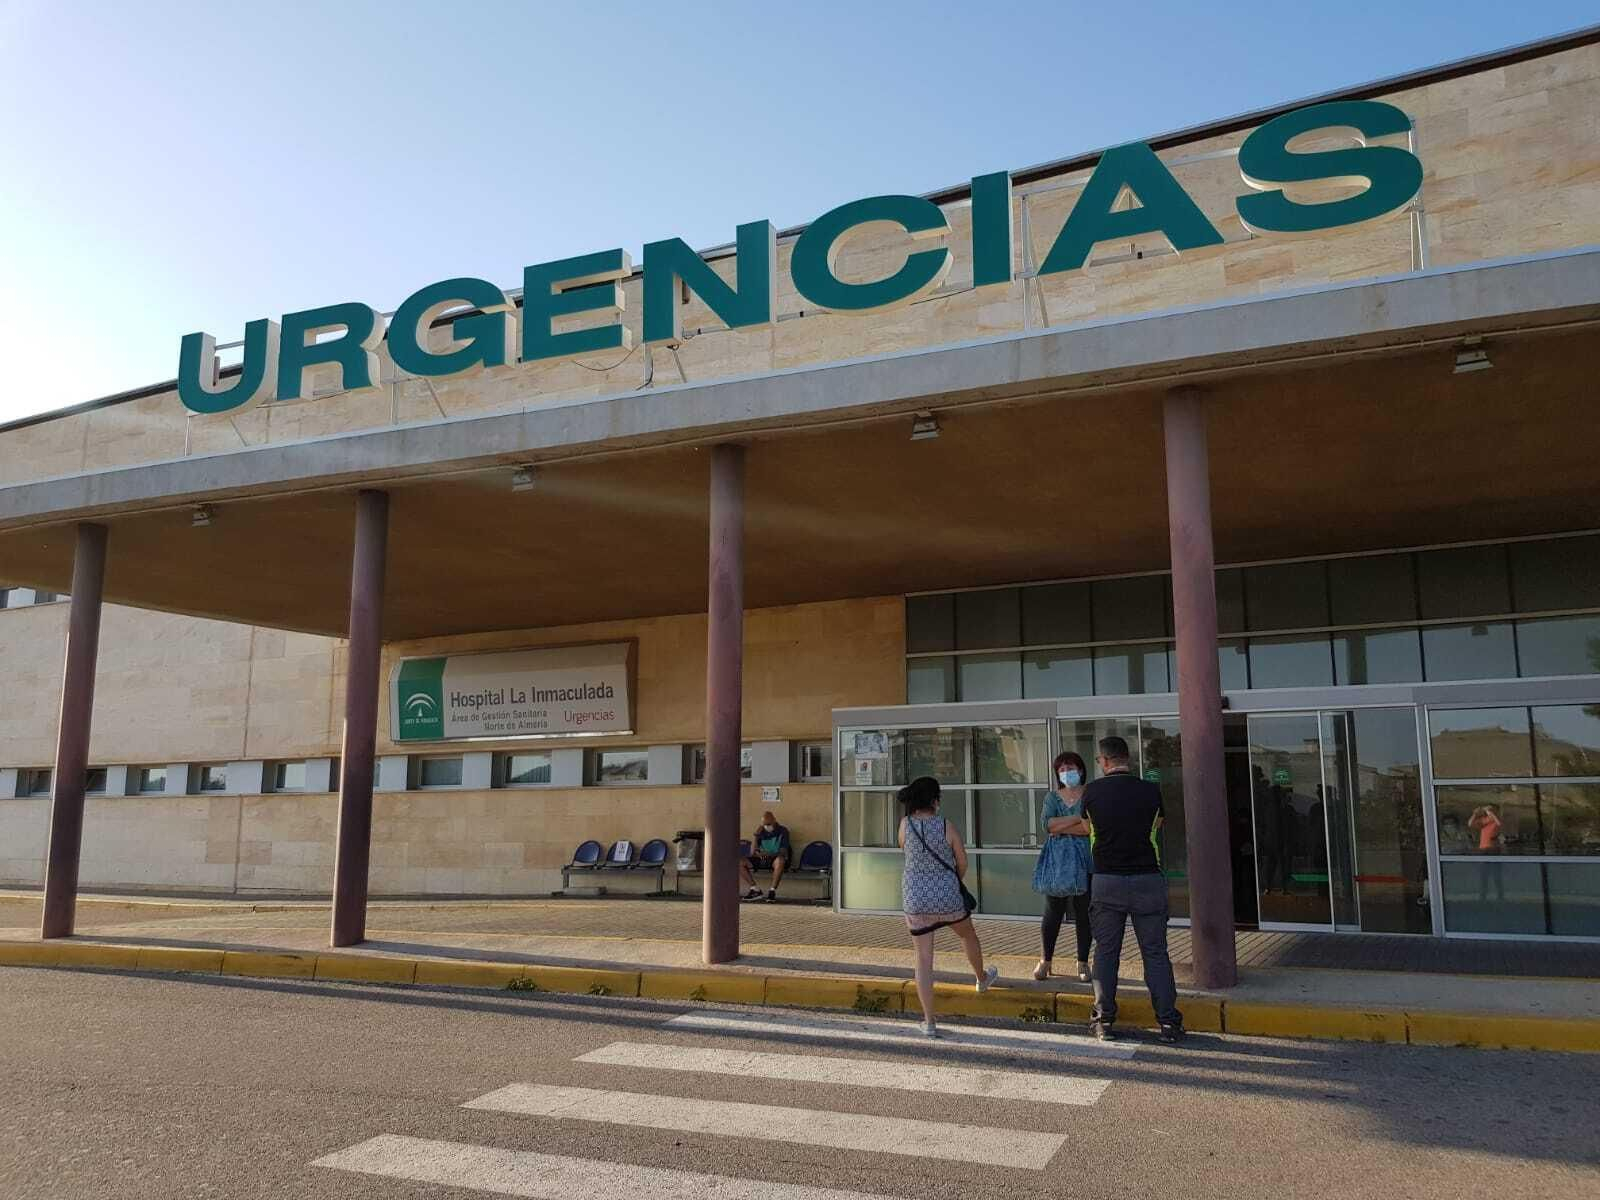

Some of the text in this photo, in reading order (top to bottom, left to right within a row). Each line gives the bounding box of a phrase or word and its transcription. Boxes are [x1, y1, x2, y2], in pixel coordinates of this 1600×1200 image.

[177, 99, 1424, 414] URGENCIAS
[450, 681, 614, 711] Hospital La Inmaculada
[471, 713, 480, 722] de
[512, 709, 548, 719] Sanitaria
[563, 709, 616, 725] Urgencias
[484, 721, 504, 731] Norte
[506, 721, 516, 730] de
